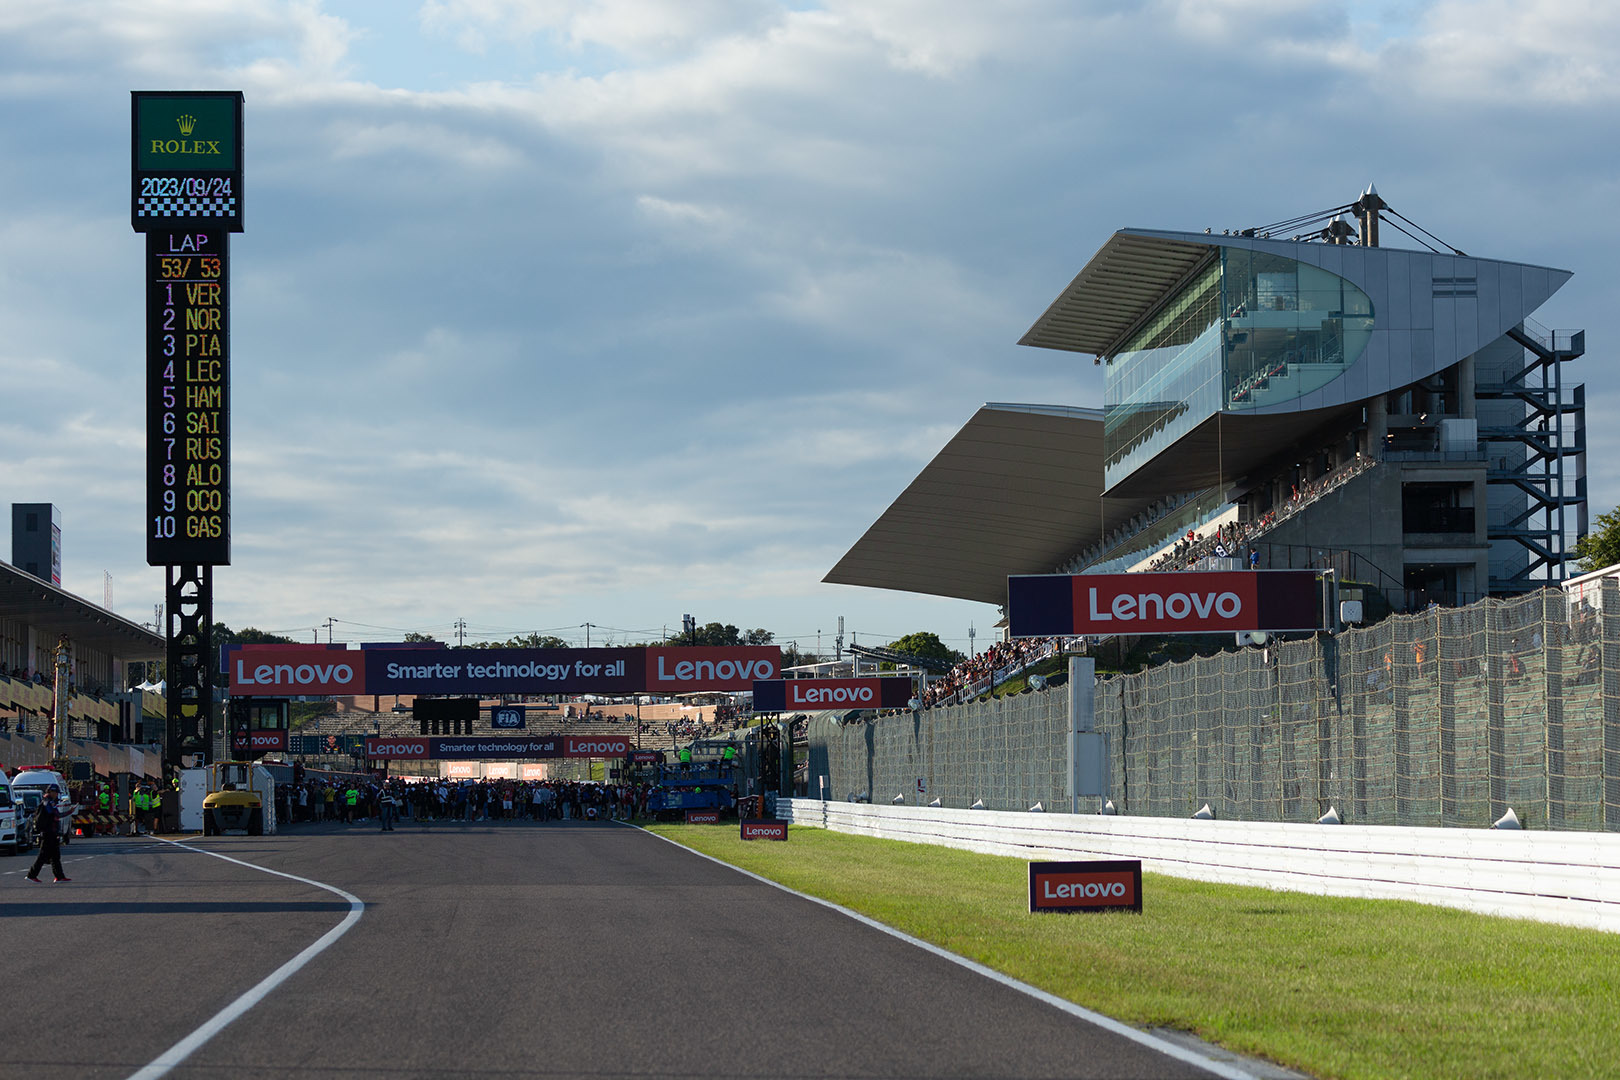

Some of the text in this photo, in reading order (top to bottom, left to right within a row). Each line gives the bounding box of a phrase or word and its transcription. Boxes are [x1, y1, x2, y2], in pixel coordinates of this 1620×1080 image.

[151, 140, 221, 154] ROLEX
[141, 177, 232, 197] 2023/09/24
[169, 234, 208, 252] LAP
[161, 258, 221, 278] 53/ 53
[165, 283, 221, 305] 1 VER
[163, 308, 221, 330] 2 NOR
[163, 334, 221, 356] 3 PIA
[163, 360, 221, 382] 4 LEC
[163, 386, 221, 408] 5 HAM
[163, 412, 221, 434] 6 SAI
[163, 438, 221, 460] 7 RUS
[163, 463, 221, 486] 8 ALO
[163, 489, 221, 512] 9 OCO
[154, 515, 221, 538] 10 GAS
[1089, 587, 1242, 621] Lenovo
[237, 659, 353, 684] Lenovo
[386, 660, 625, 681] Smarter technology for all
[658, 655, 774, 681] Lenovo
[793, 685, 873, 703] Lenovo
[498, 714, 519, 724] FIA
[368, 742, 425, 755] Lenovo
[439, 742, 554, 753] Smarter technology for all
[569, 740, 626, 754] Lenovo
[746, 827, 782, 836] Lenovo
[1044, 880, 1126, 899] Lenovo
